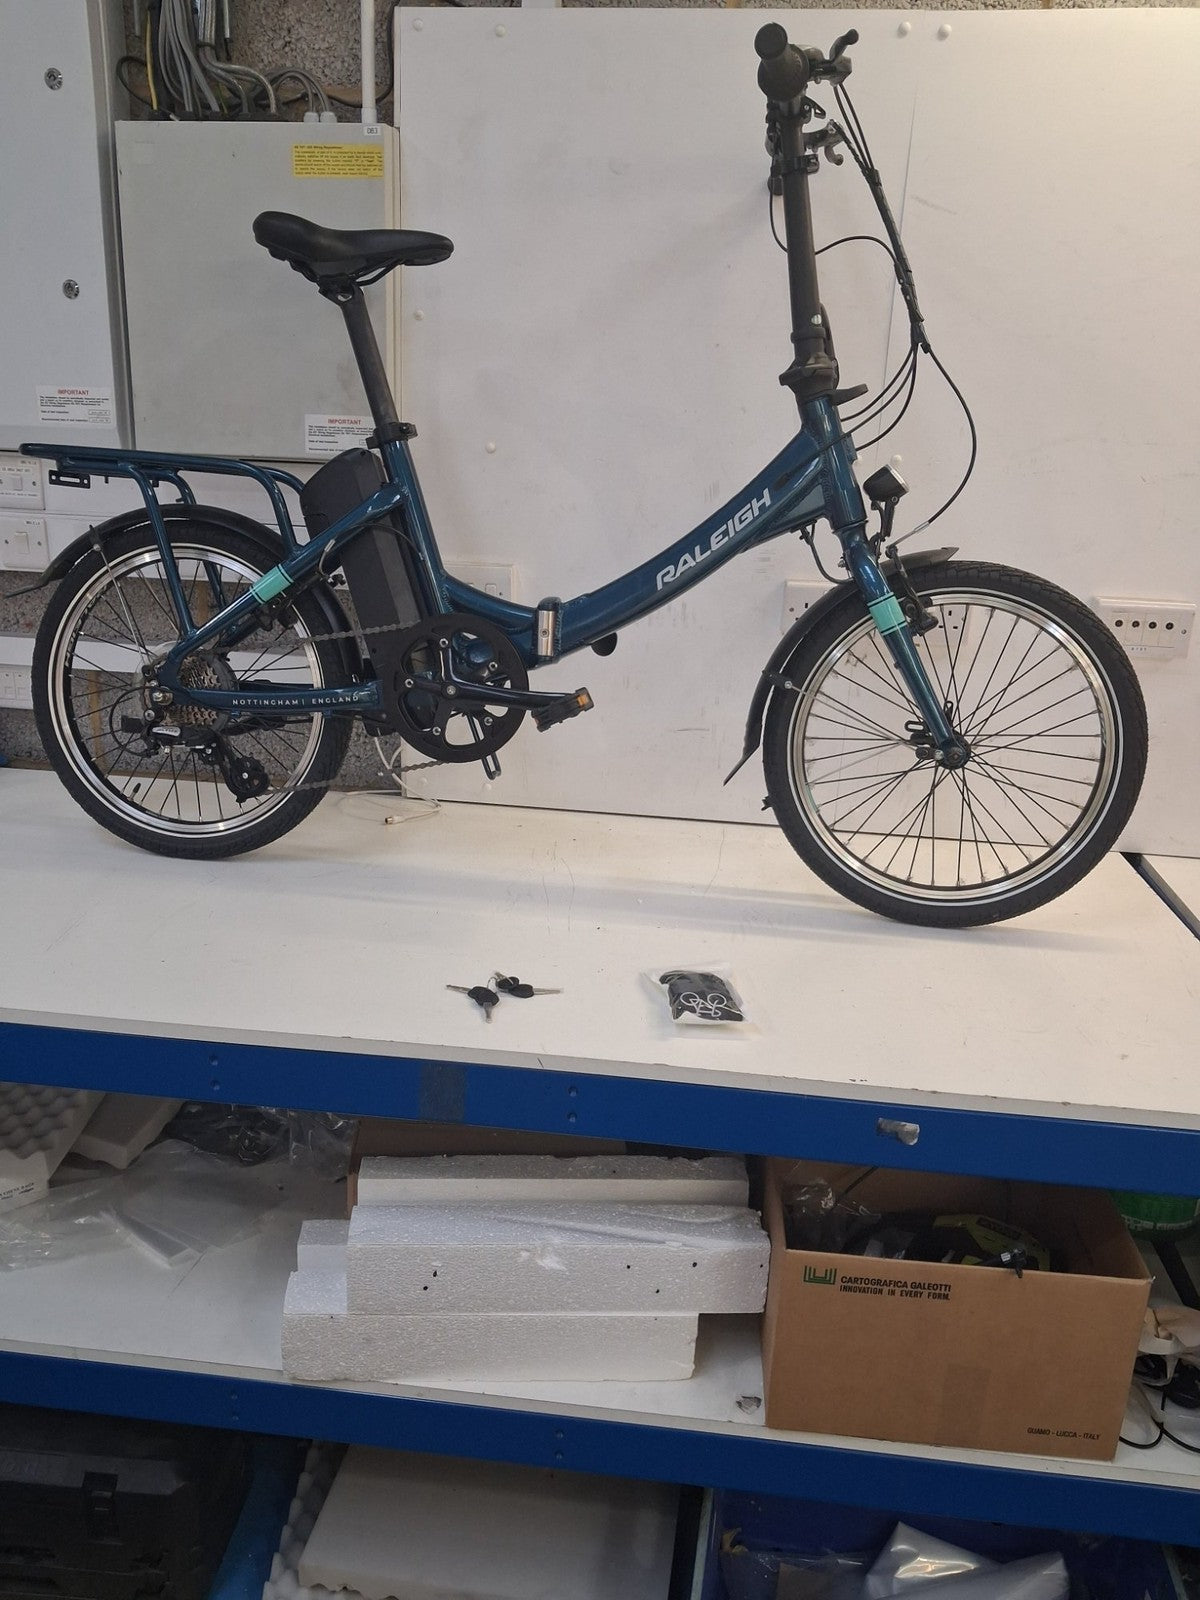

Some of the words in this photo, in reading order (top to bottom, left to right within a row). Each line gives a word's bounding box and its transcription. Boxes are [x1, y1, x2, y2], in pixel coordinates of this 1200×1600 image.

[366, 127, 378, 135] DB3
[656, 487, 772, 591] RALEIGH
[311, 696, 359, 705] ENGLAND
[840, 1276, 908, 1289] CARTOGRAFICA
[910, 1282, 952, 1293] GALEOTTI
[839, 1285, 883, 1296] INNOVATION
[887, 1289, 896, 1297] IN
[900, 1290, 924, 1299] EVERY
[1056, 1430, 1078, 1439] LUCCA
[1083, 1432, 1101, 1441] ITALY
